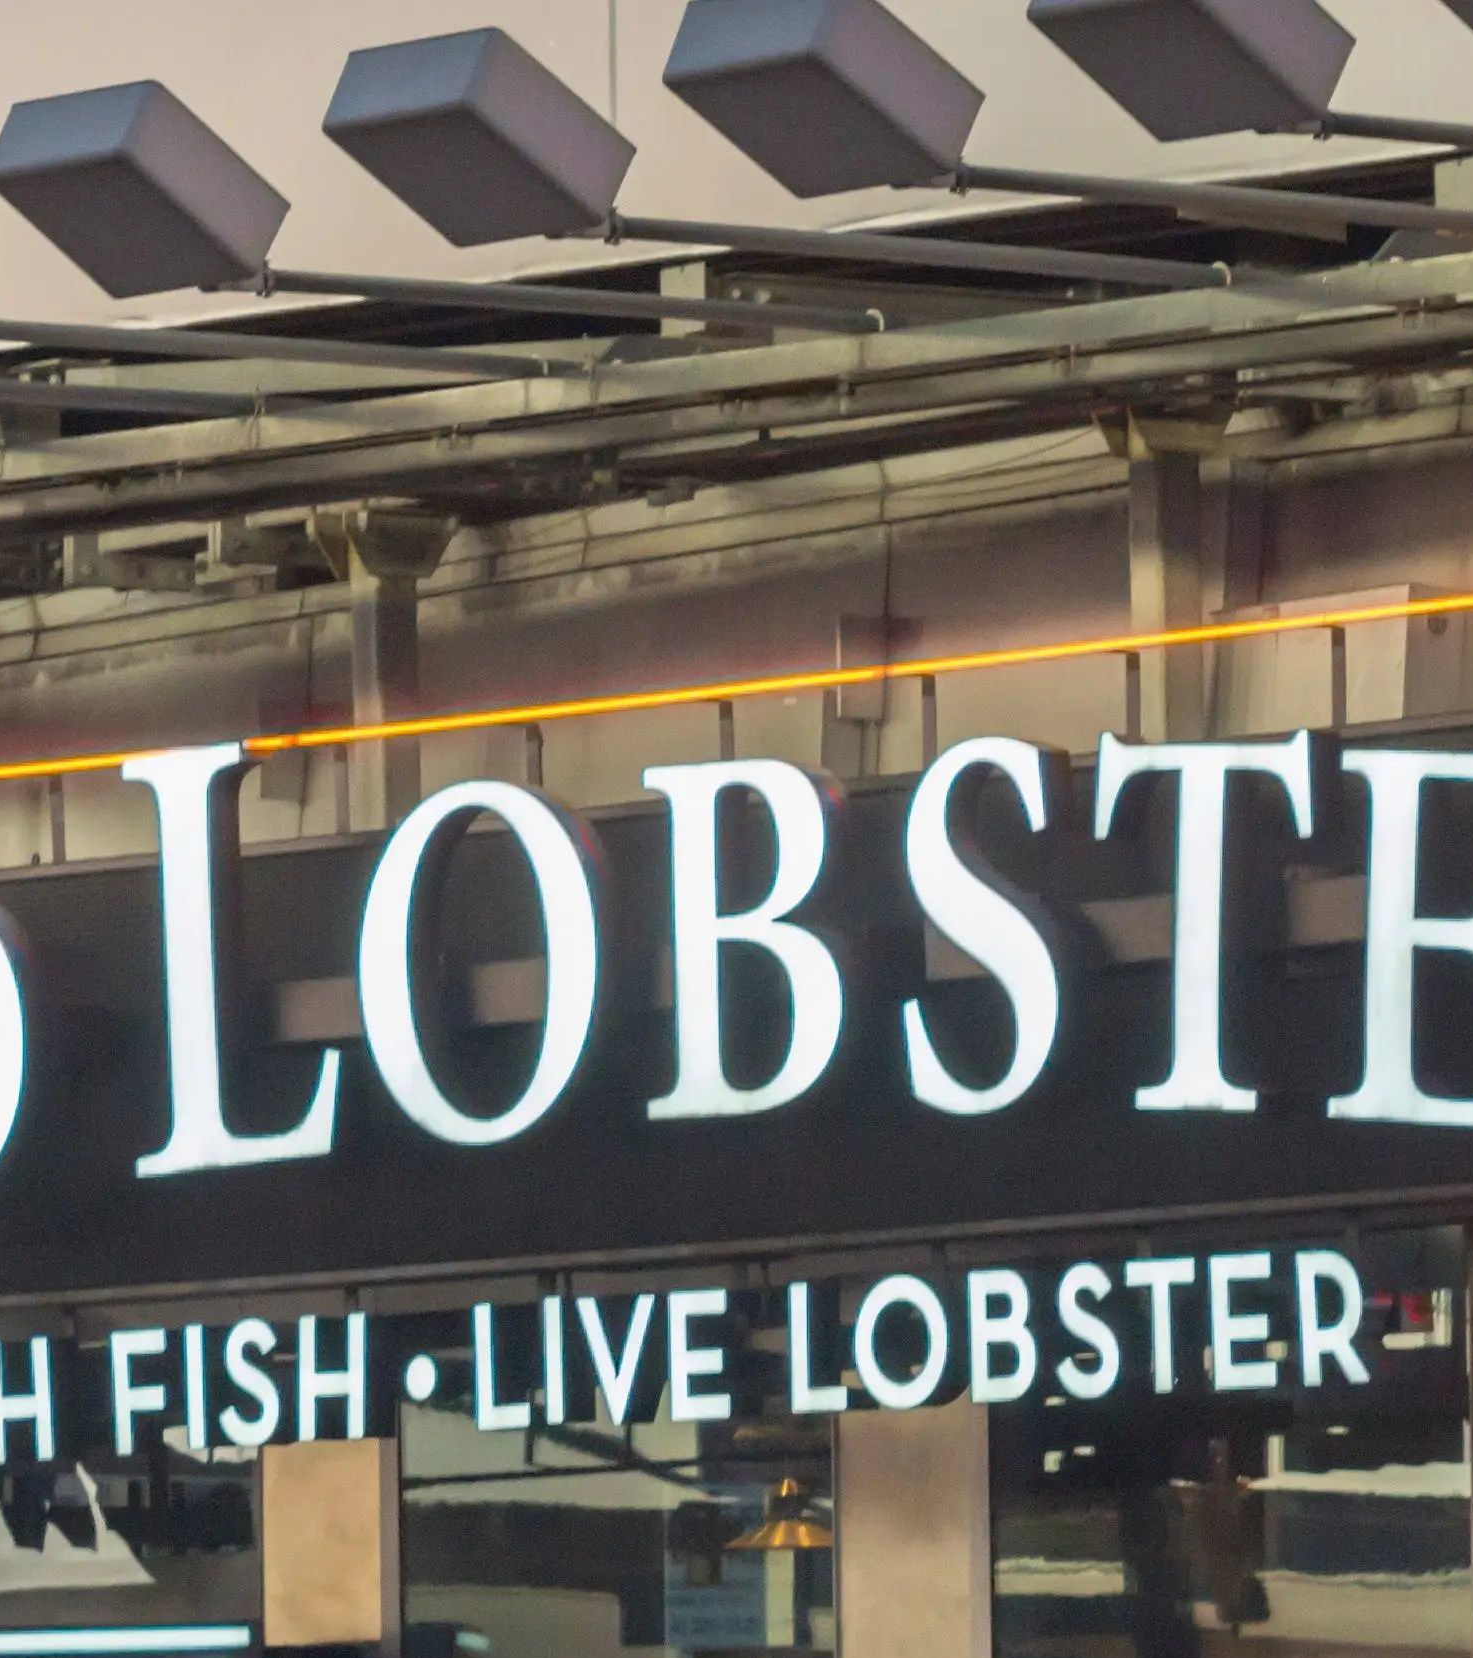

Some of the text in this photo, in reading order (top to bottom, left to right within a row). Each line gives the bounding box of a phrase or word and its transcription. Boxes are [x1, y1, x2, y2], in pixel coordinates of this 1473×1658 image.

[110, 1309, 367, 1456] FISH
[472, 1288, 733, 1433] LIVE
[789, 1247, 1370, 1416] LOBSTER
